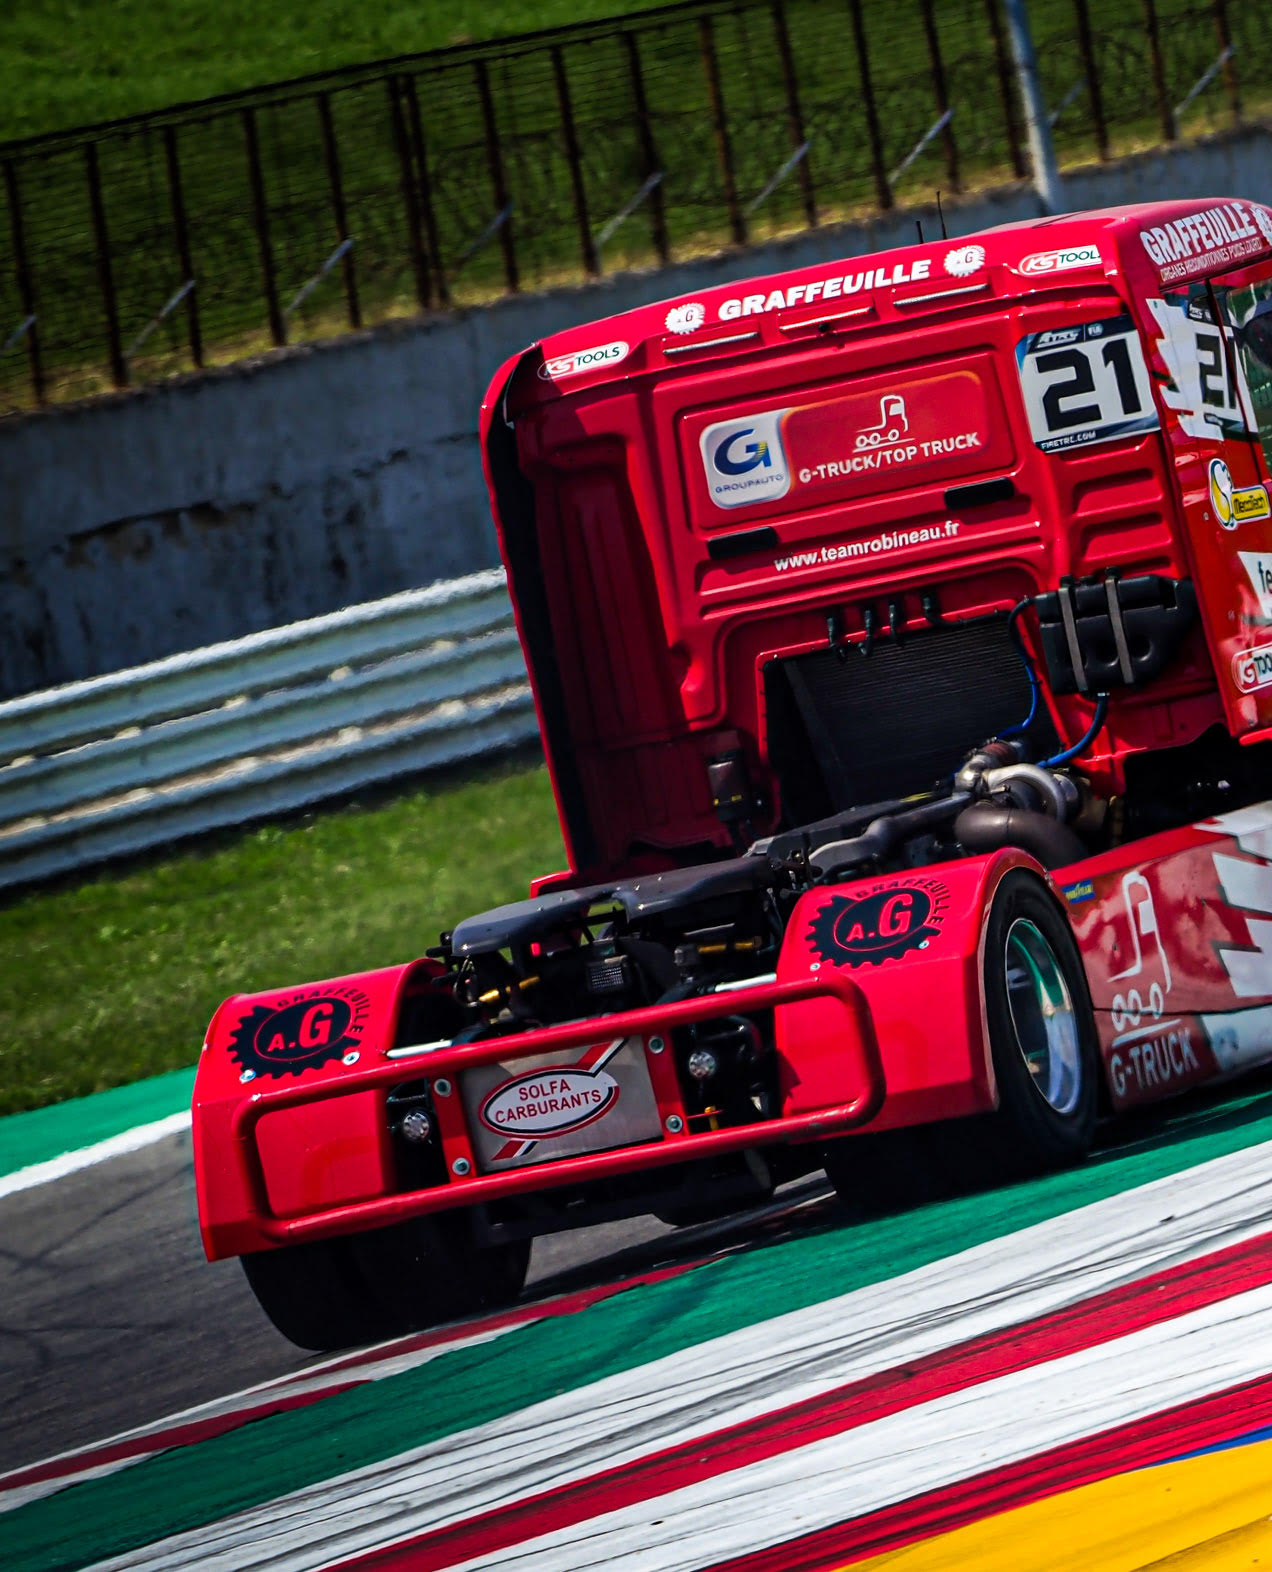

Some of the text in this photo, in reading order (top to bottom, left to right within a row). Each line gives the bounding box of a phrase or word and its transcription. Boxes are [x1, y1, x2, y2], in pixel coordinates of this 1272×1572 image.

[1058, 249, 1101, 264] TOOL
[1139, 202, 1257, 266] GRAFFEUILLE
[718, 259, 932, 321] GRAFFEUILLE
[575, 346, 620, 366] TOOLS
[1035, 338, 1142, 432] 21
[800, 432, 981, 484] G-TRUCK/TOP TRUCK
[715, 473, 784, 494] GROUPAUTO
[774, 520, 960, 572] www.teamrobineau.fr
[846, 893, 914, 942] A.G
[856, 878, 951, 924] GRAFFEUILLE
[267, 1002, 334, 1052] A.G
[277, 987, 371, 1033] GRAFFEUILLE
[1111, 1027, 1199, 1096] G-TRUCK
[495, 1089, 602, 1124] CARBURANTS
[519, 1079, 572, 1101] SOLFA
